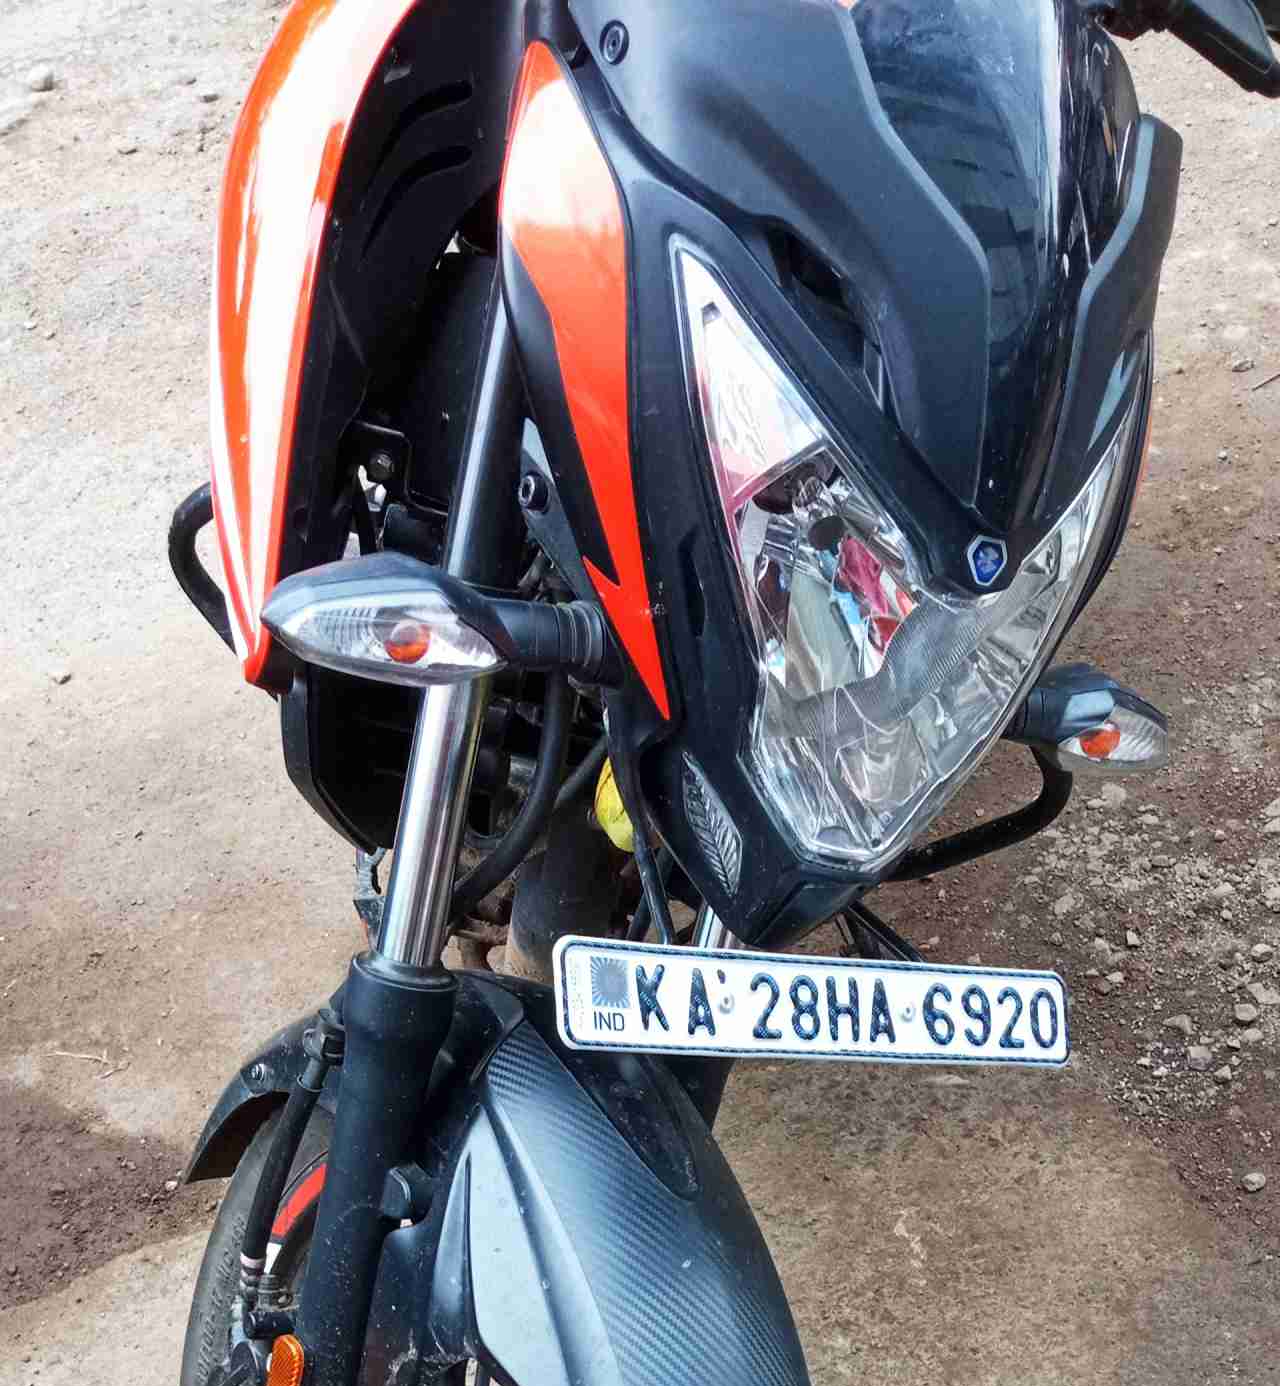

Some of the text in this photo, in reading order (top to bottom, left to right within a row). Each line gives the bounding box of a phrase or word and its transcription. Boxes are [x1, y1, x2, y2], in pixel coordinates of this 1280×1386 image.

[592, 1010, 625, 1032] IND
[635, 964, 717, 1036] KA
[749, 971, 897, 1043] 28HA
[922, 981, 1059, 1049] 6920
